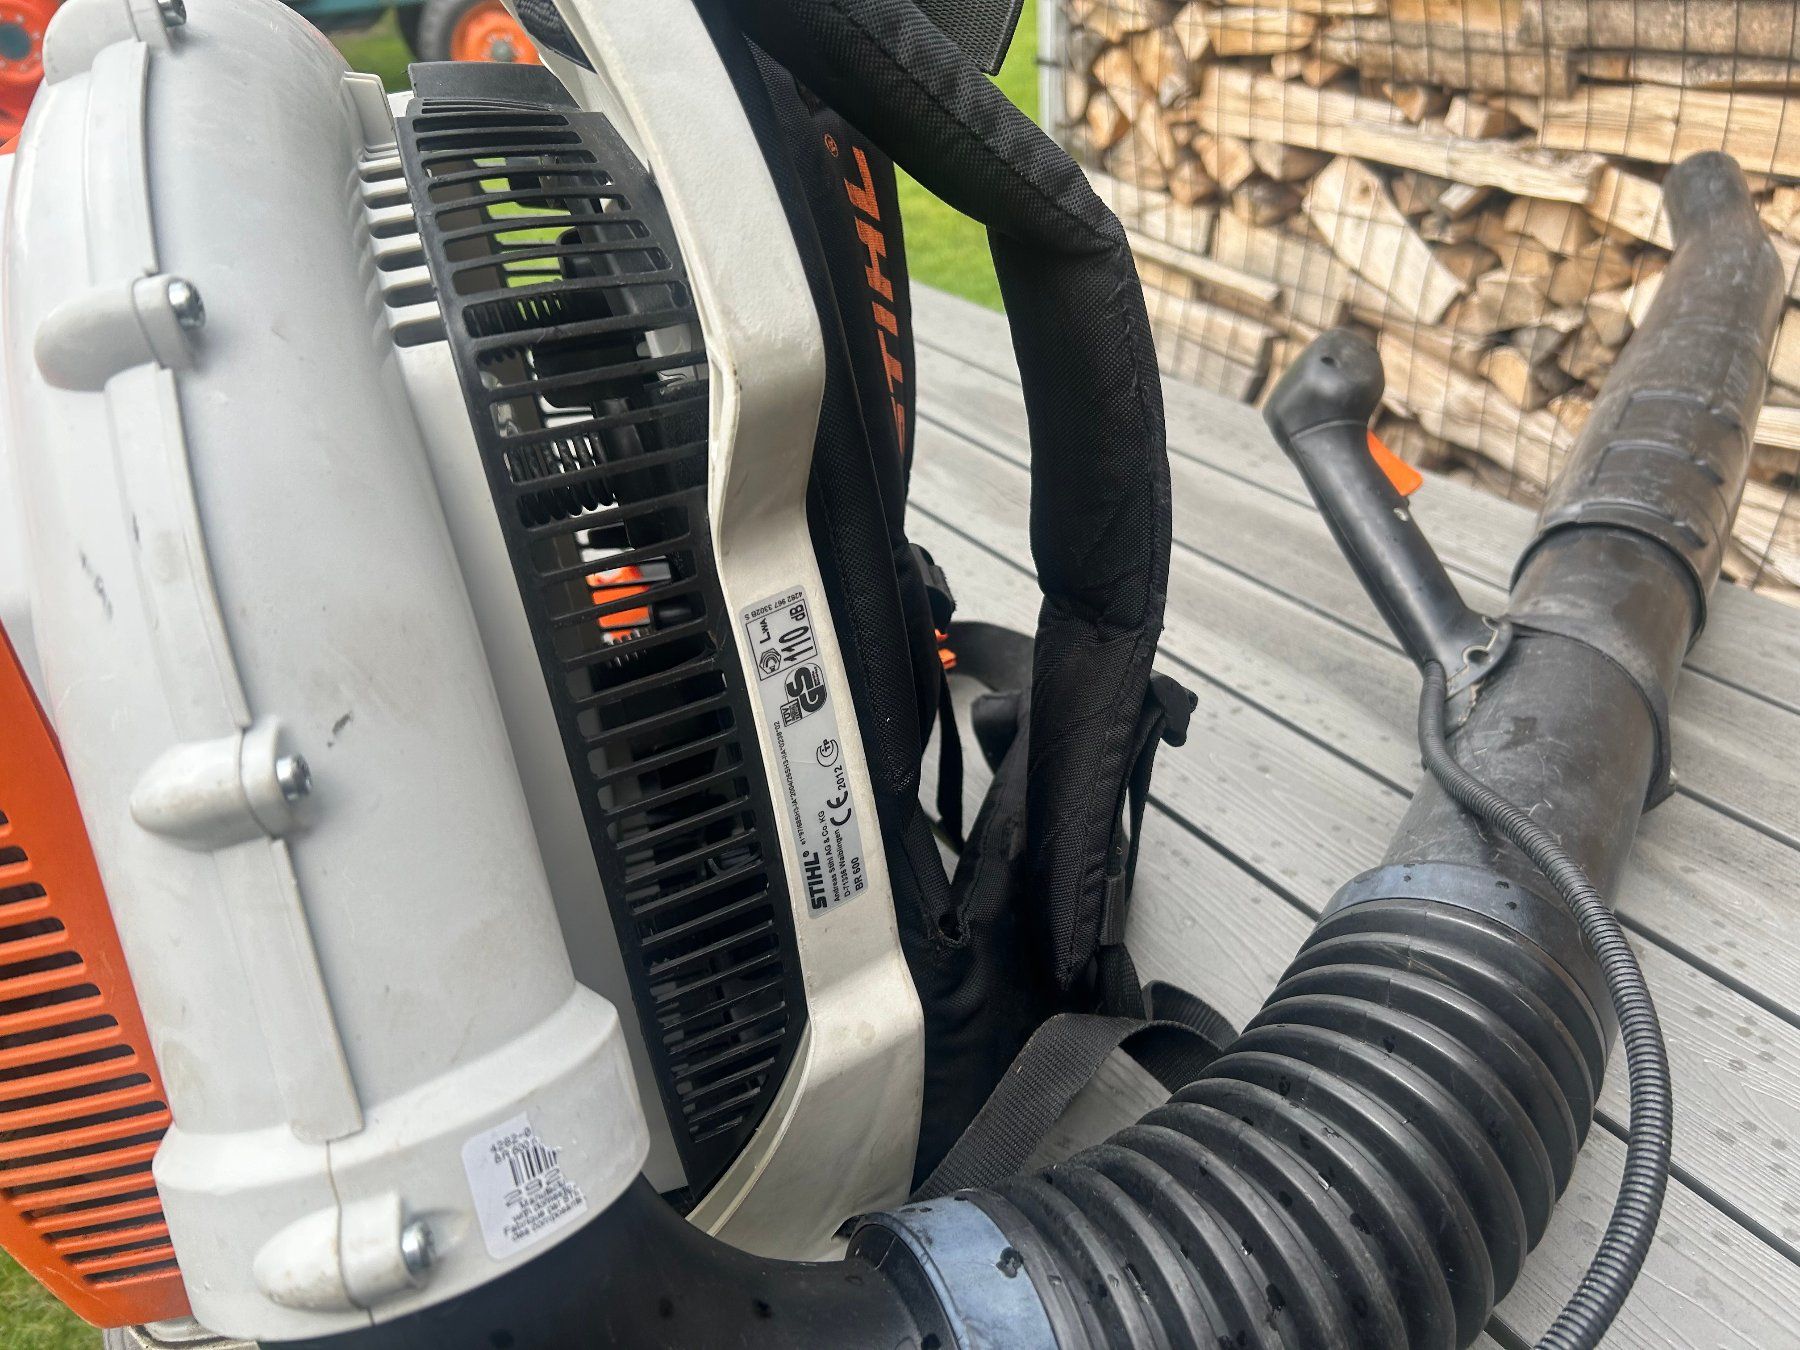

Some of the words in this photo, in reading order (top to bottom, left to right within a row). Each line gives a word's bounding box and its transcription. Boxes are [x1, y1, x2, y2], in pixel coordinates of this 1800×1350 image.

[844, 146, 906, 456] STIHL
[789, 604, 806, 622] dB
[778, 626, 814, 662] 110
[786, 666, 827, 713] GS
[834, 765, 846, 791] 2012
[817, 810, 826, 824] KG
[826, 790, 852, 827] CE
[823, 836, 830, 844] &
[824, 844, 833, 856] AG
[834, 829, 847, 870] Waiblingen
[826, 856, 836, 874] Stihl
[850, 857, 861, 875] 600
[802, 851, 828, 910] STIHL
[830, 873, 842, 902] Andreas
[853, 874, 864, 892] BR
